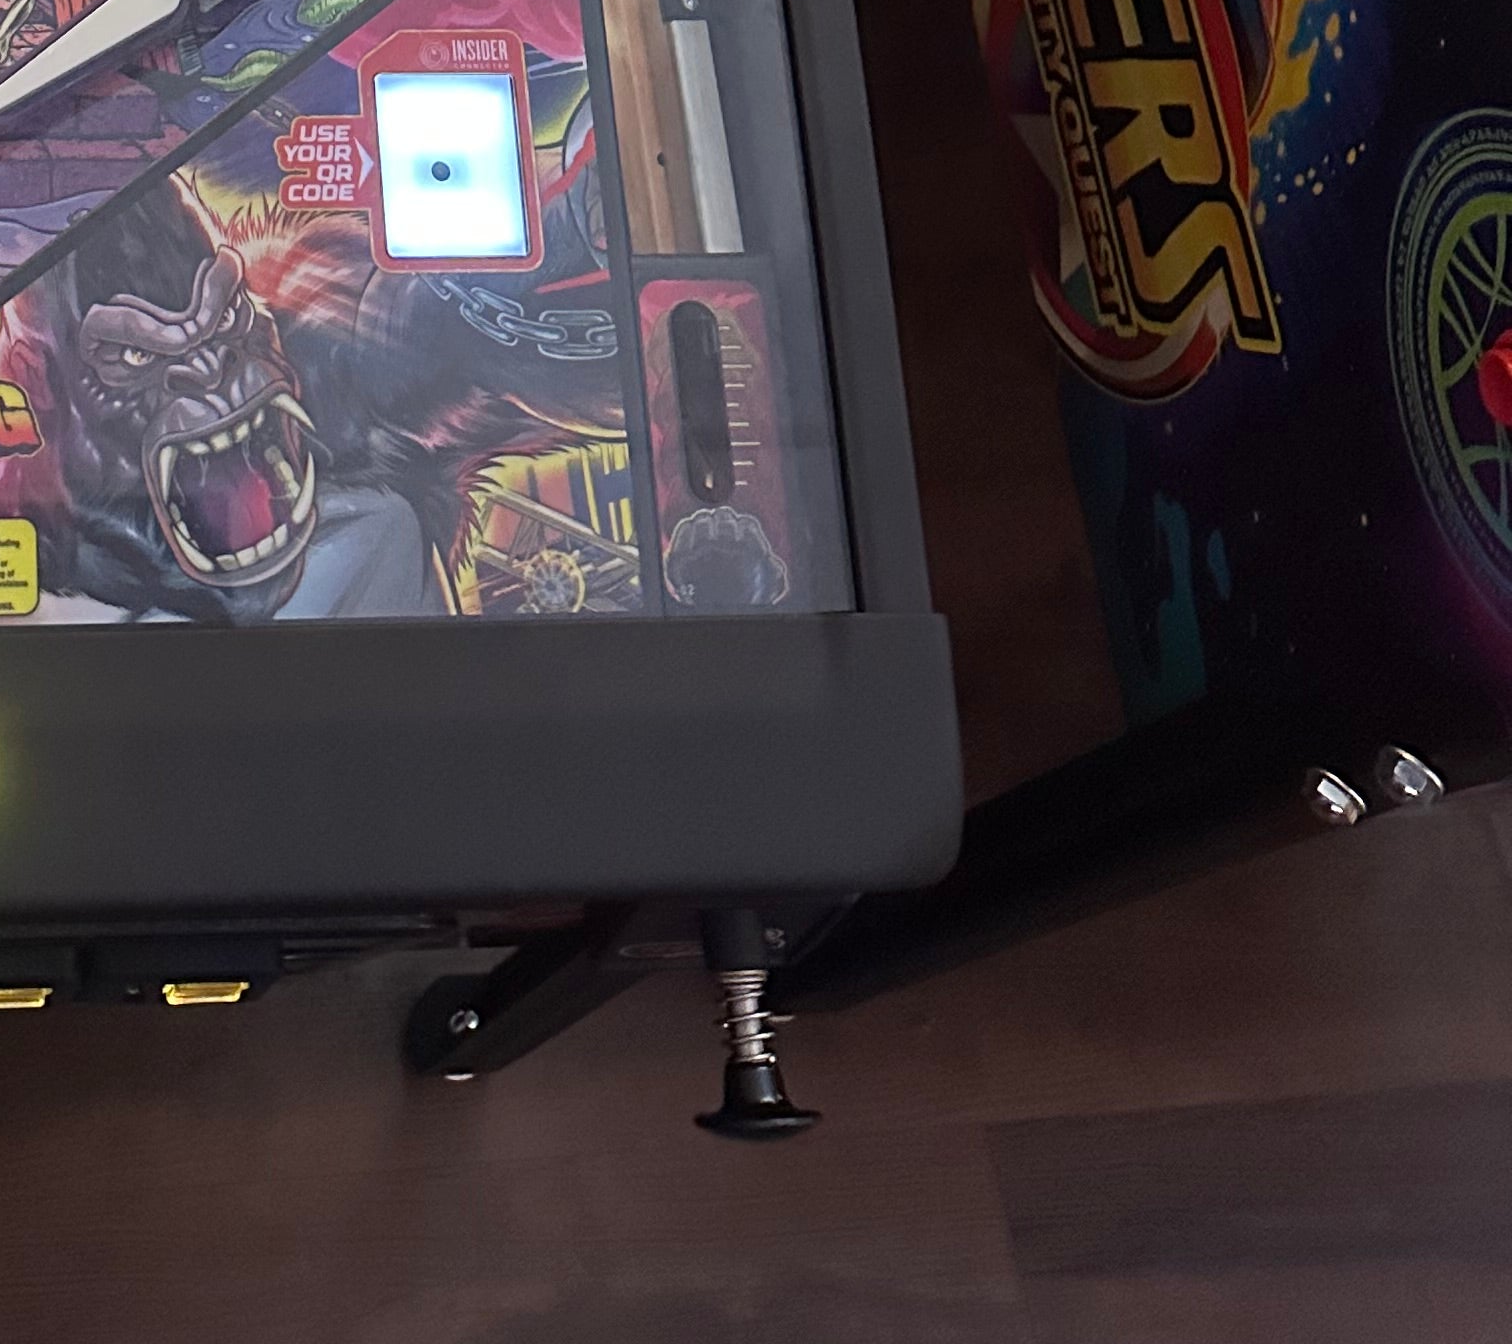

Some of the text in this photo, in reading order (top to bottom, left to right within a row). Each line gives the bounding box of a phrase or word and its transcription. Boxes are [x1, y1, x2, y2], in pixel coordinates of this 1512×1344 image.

[452, 39, 508, 62] INSIDER
[300, 125, 351, 142] USE
[284, 145, 351, 162] YOUR
[317, 164, 354, 184] QR
[288, 184, 354, 202] CODE
